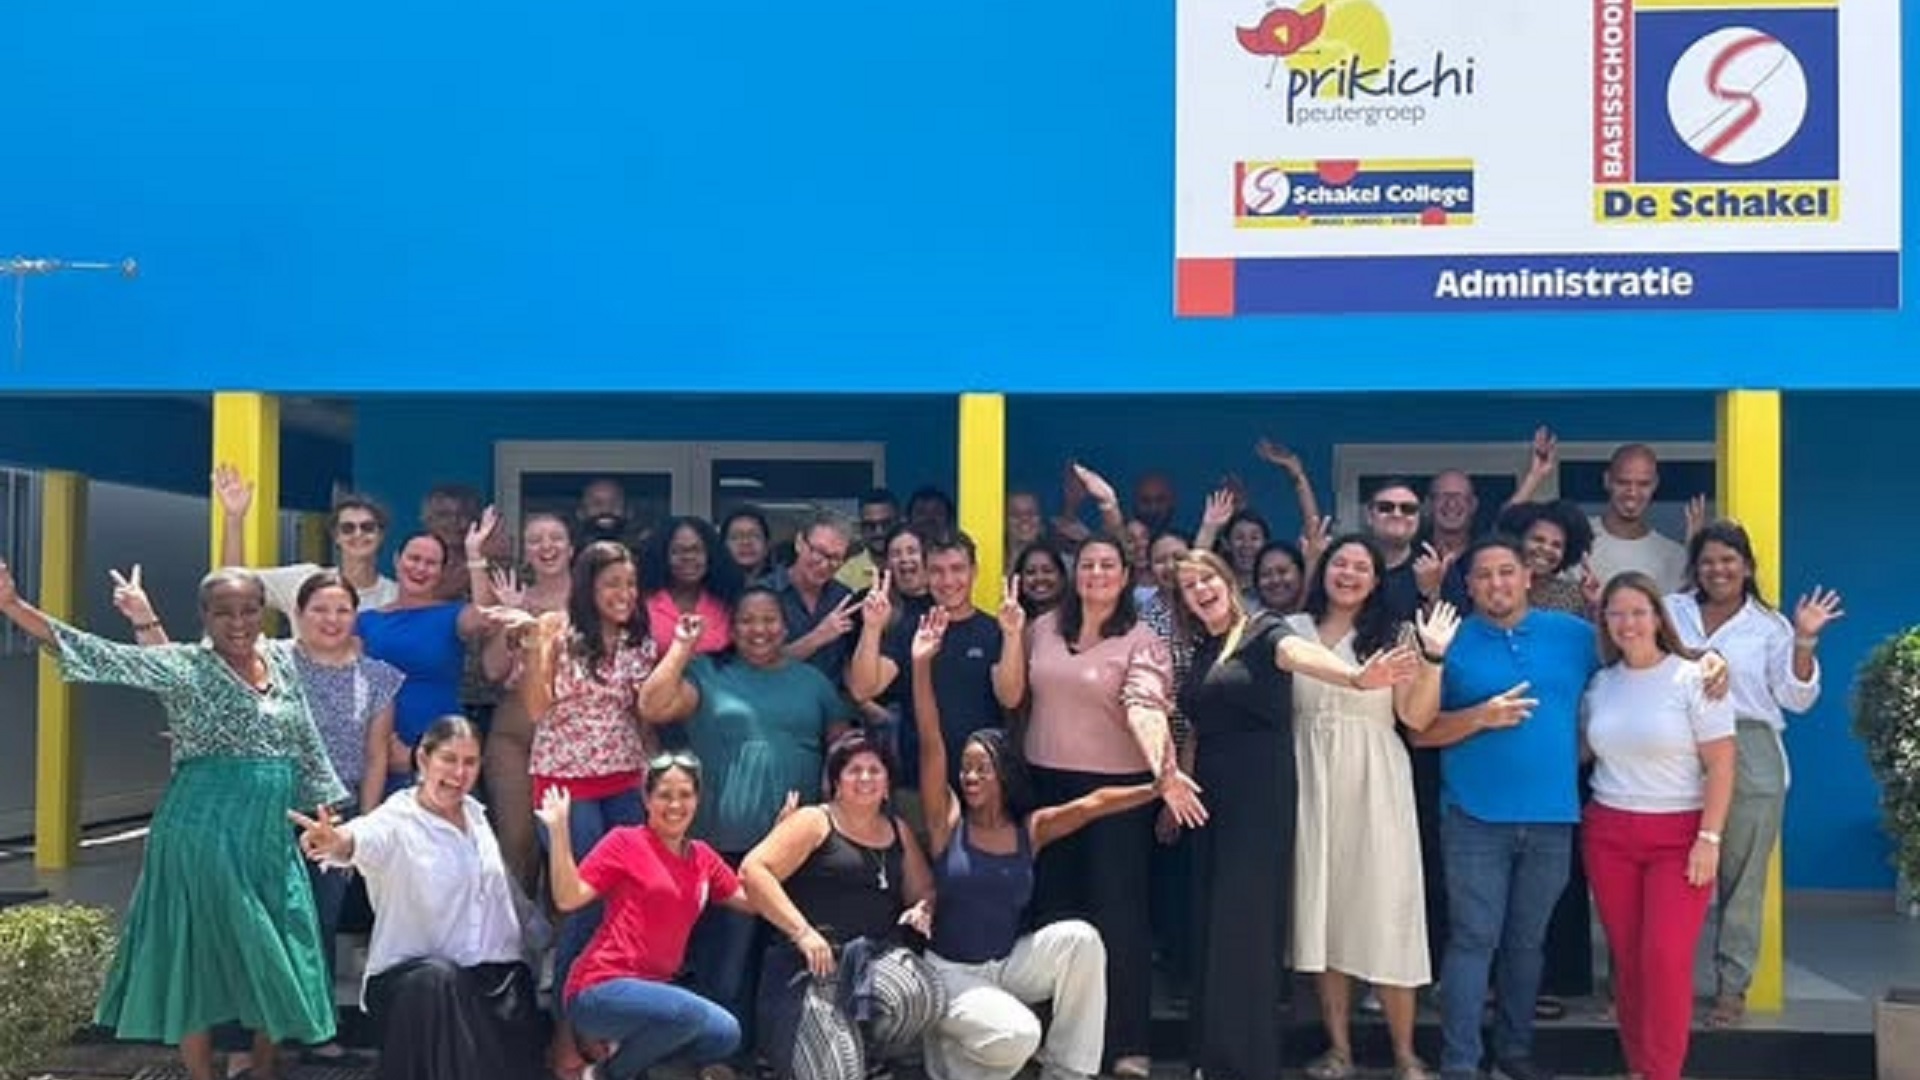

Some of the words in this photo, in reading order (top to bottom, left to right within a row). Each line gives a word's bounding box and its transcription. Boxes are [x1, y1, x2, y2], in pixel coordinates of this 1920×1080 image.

[1287, 51, 1475, 124] prikichi
[1298, 104, 1426, 125] peutergroep
[1293, 184, 1379, 204] Schakel
[1386, 184, 1470, 207] College
[1605, 191, 1657, 217] De
[1672, 188, 1829, 217] Schakel
[1435, 267, 1693, 298] Administratie
